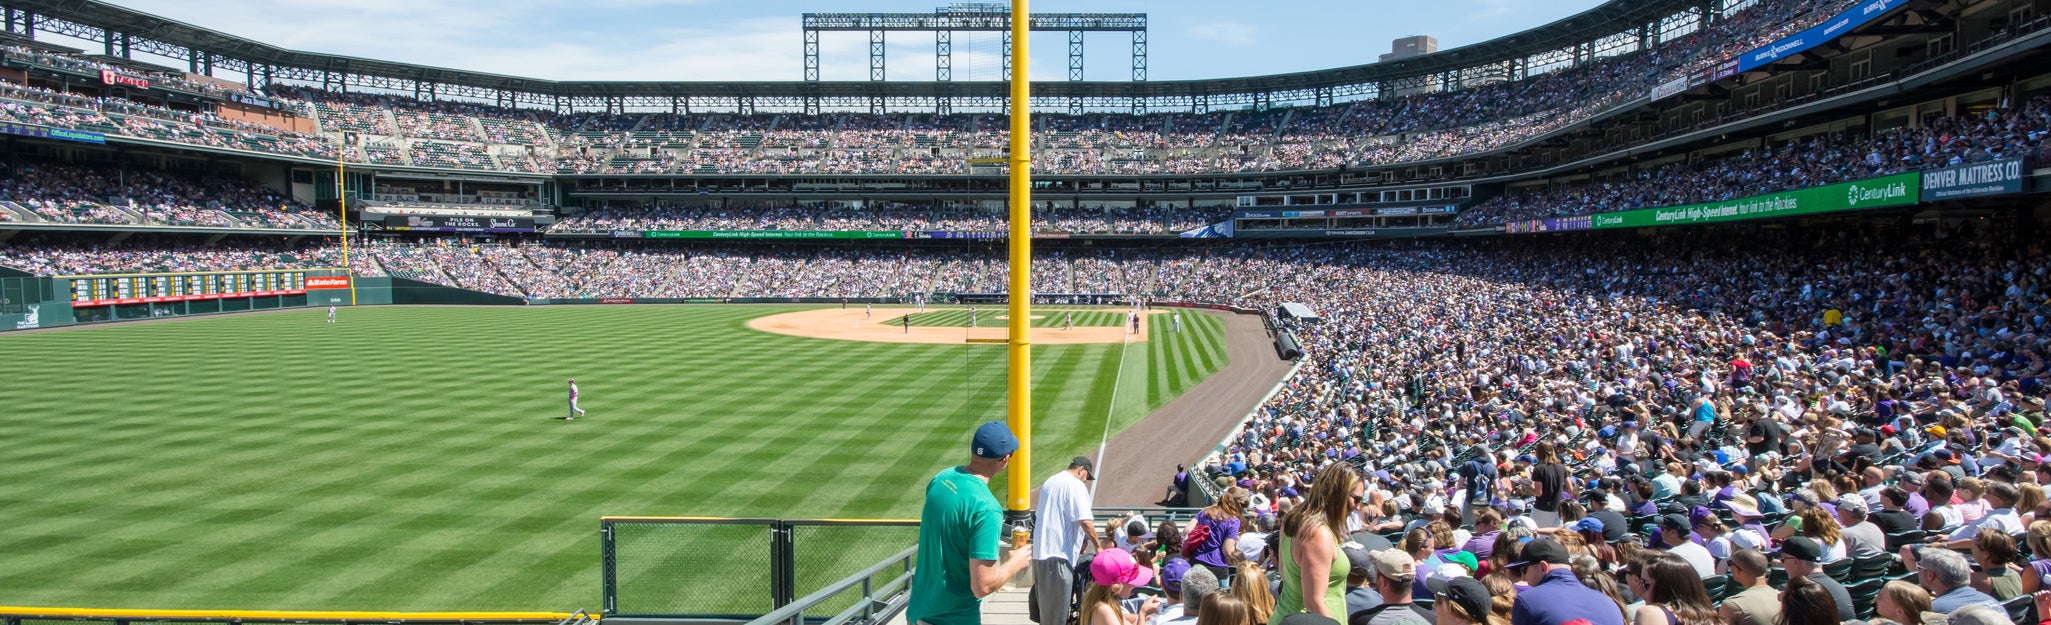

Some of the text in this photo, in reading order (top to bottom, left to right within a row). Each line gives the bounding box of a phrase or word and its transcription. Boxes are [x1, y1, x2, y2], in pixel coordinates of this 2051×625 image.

[51, 128, 105, 142] OfficeLiquidators.com
[1923, 170, 1956, 190] DENVER
[1959, 163, 2003, 186] MATTRESS
[1859, 182, 1906, 201] CenturyLink
[1655, 208, 1687, 222] CenturyLink
[1687, 205, 1720, 221] High-Speed
[1750, 201, 1758, 212] link
[1759, 202, 1765, 212] to
[1765, 198, 1774, 211] the
[490, 218, 507, 228] Shane
[1602, 216, 1623, 225] CenturyLink
